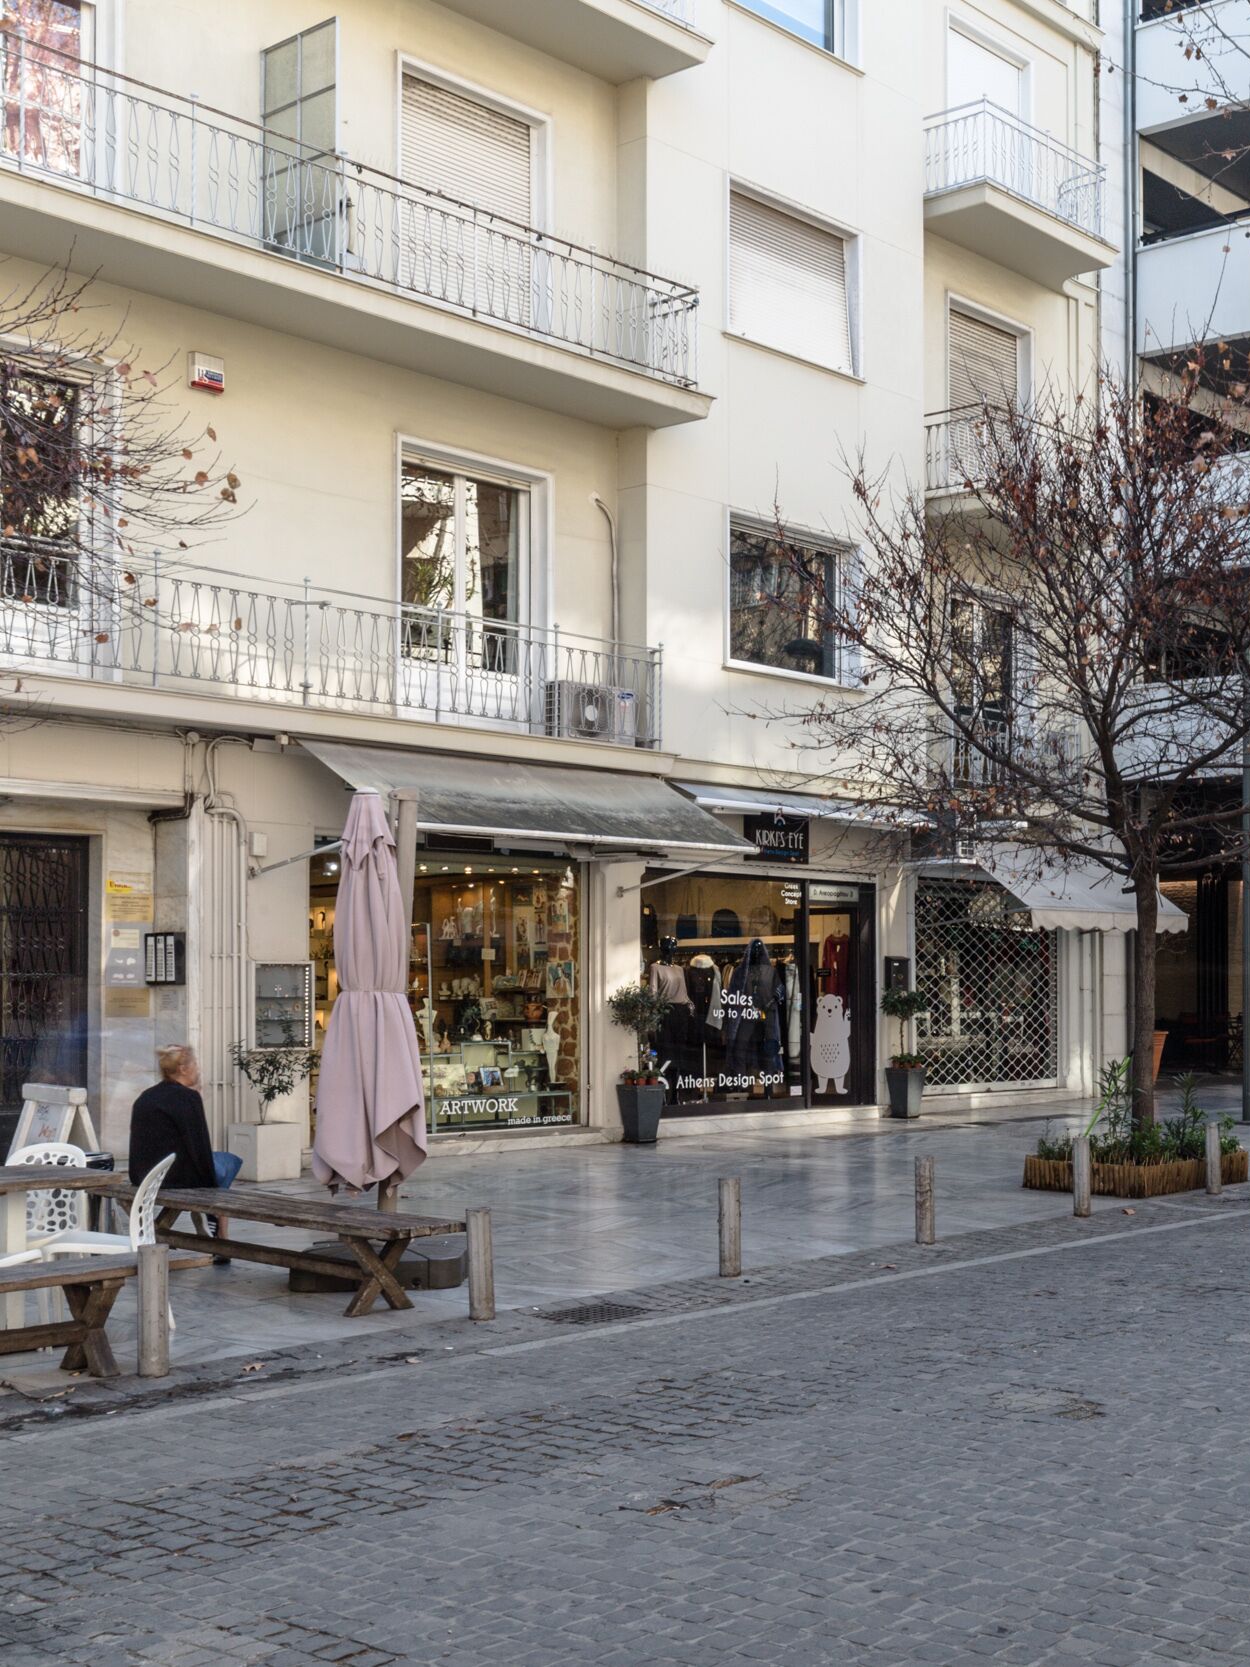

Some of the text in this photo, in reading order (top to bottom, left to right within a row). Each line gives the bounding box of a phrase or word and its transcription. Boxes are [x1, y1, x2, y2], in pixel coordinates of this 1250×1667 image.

[755, 829, 804, 849] KIRKI'S EYE
[780, 890, 802, 898] Concept
[720, 988, 753, 1006] Sales
[713, 1008, 760, 1019] up to 40%
[676, 1071, 785, 1089] Athens Design Spot
[439, 1097, 519, 1116] ARTWORK
[507, 1114, 572, 1126] made in greece
